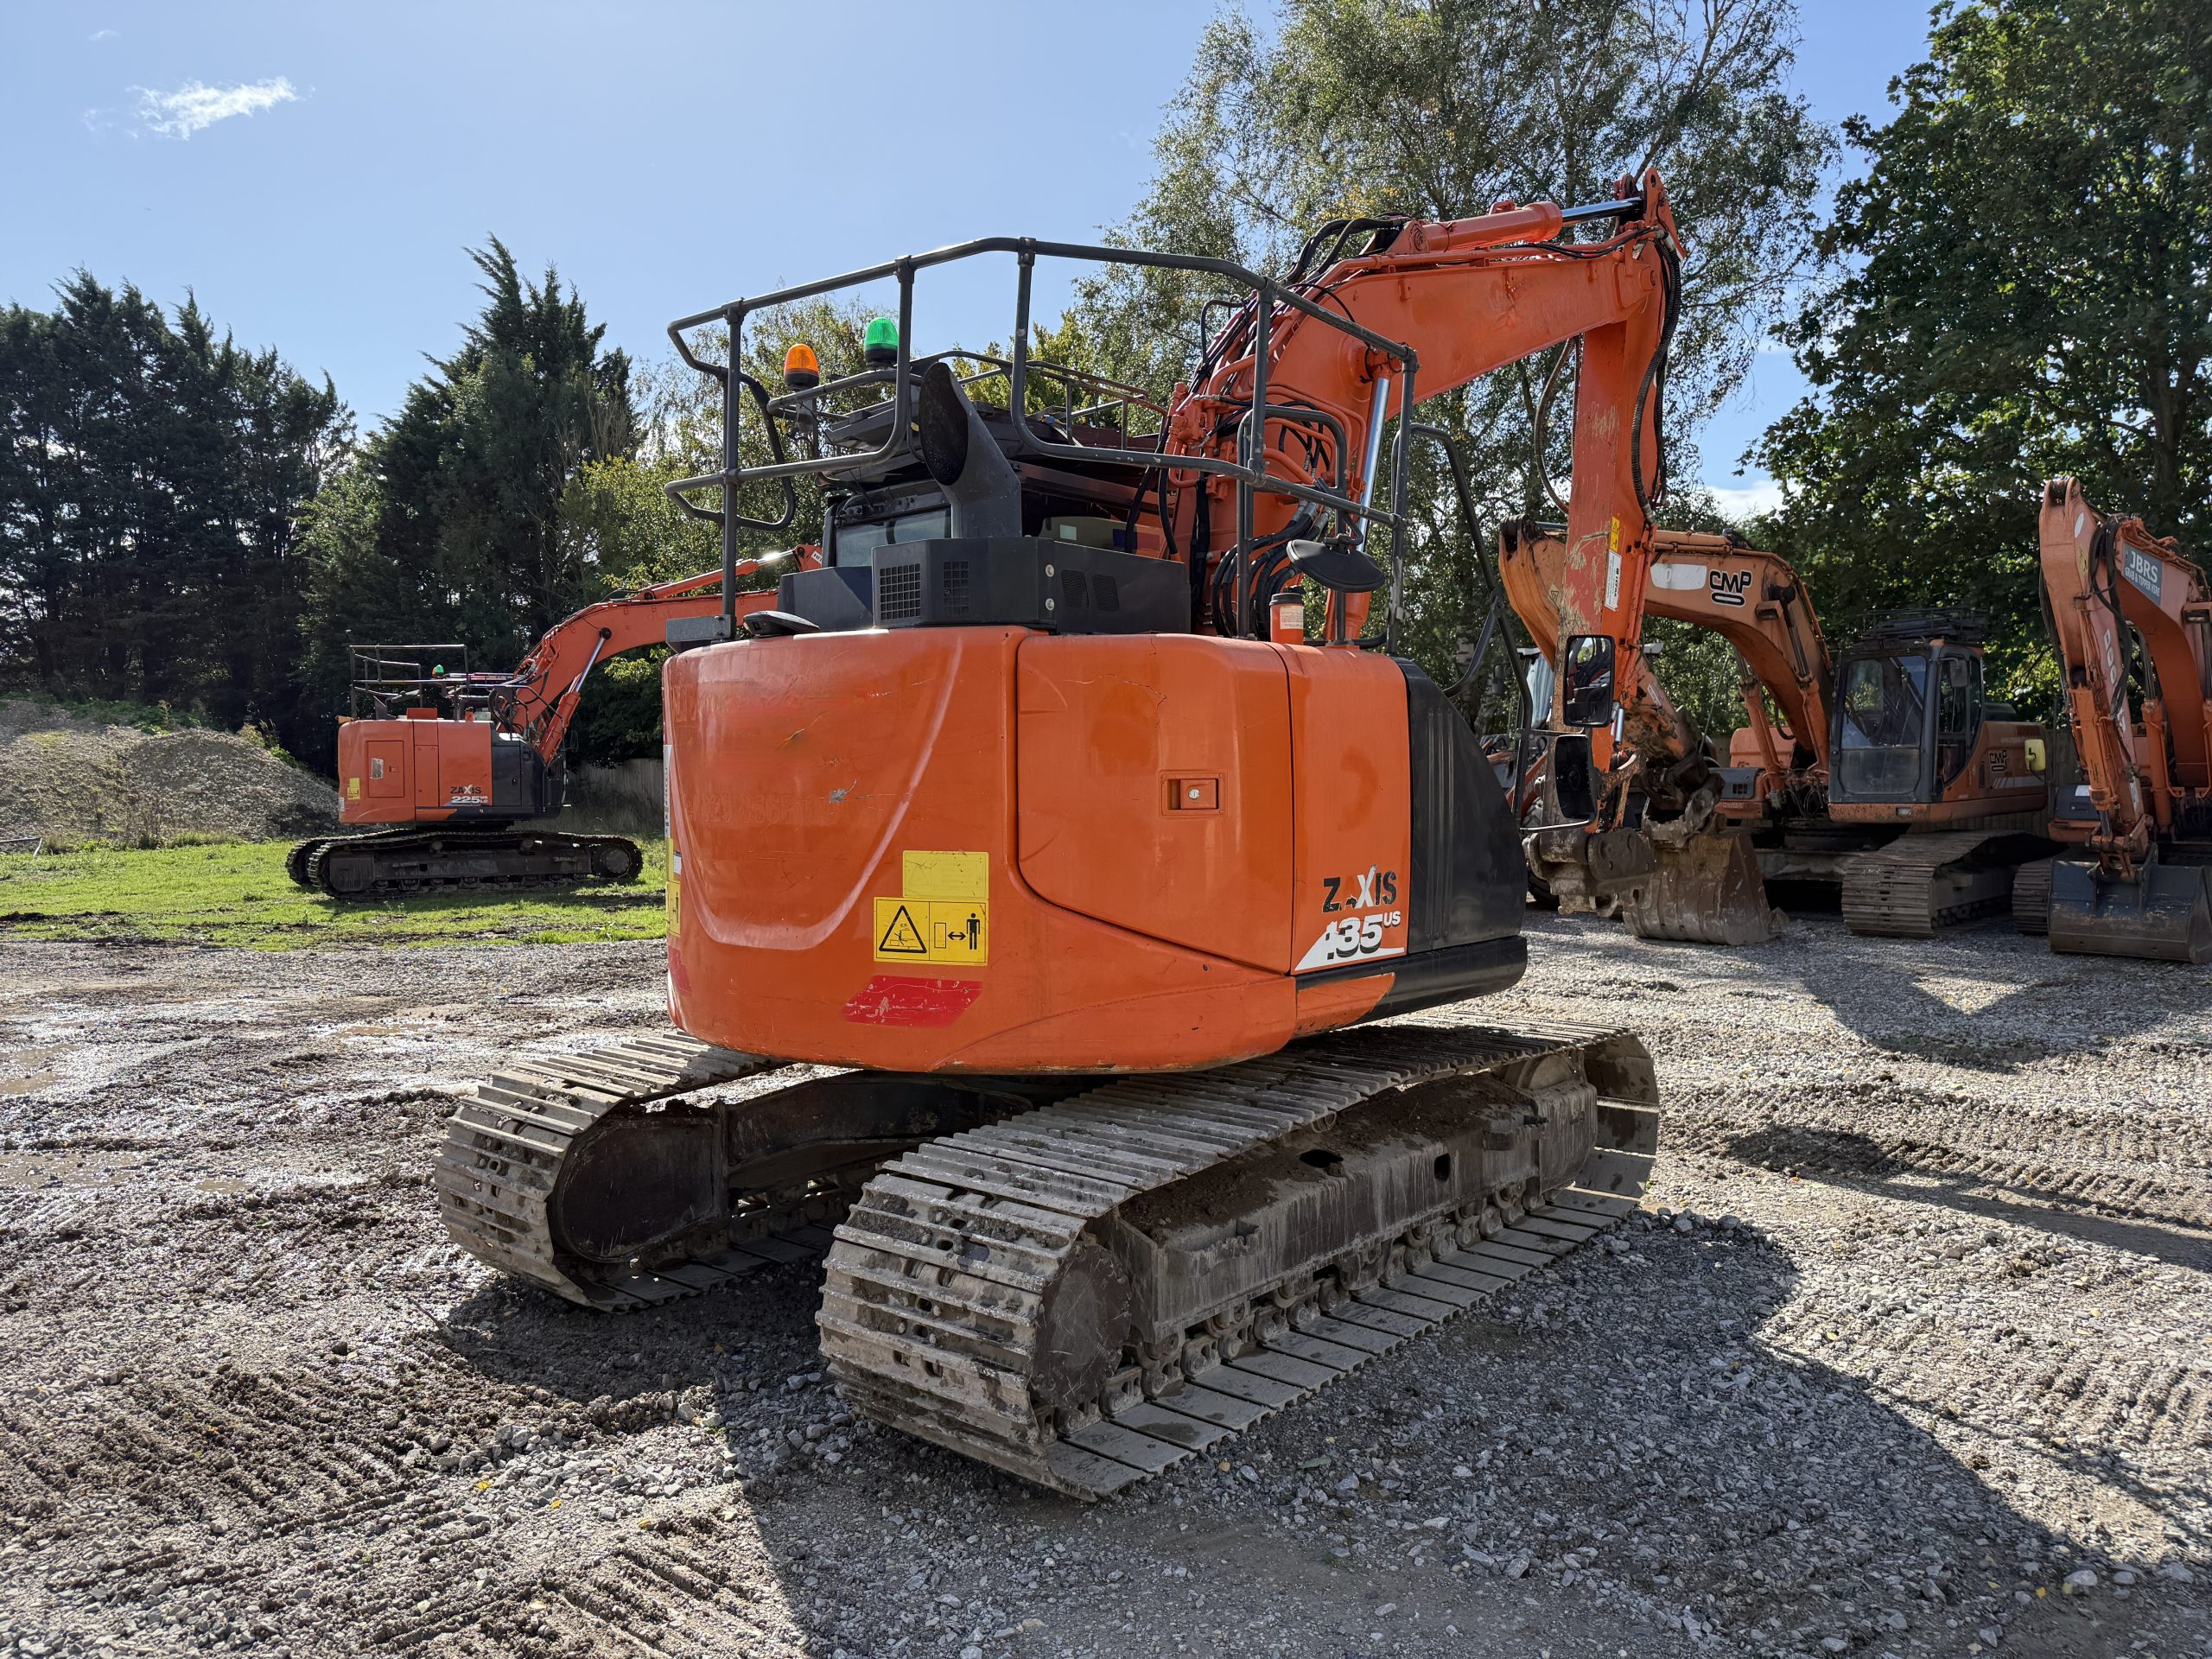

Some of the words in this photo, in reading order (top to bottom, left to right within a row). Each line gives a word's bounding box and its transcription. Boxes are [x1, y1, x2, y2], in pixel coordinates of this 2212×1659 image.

[2130, 550, 2158, 583] JBRS
[1710, 570, 1752, 594] CMP
[1989, 749, 2007, 764] CMP
[450, 784, 481, 794] ZAXIS
[451, 796, 480, 804] 225
[1322, 864, 1397, 912] ZXIS
